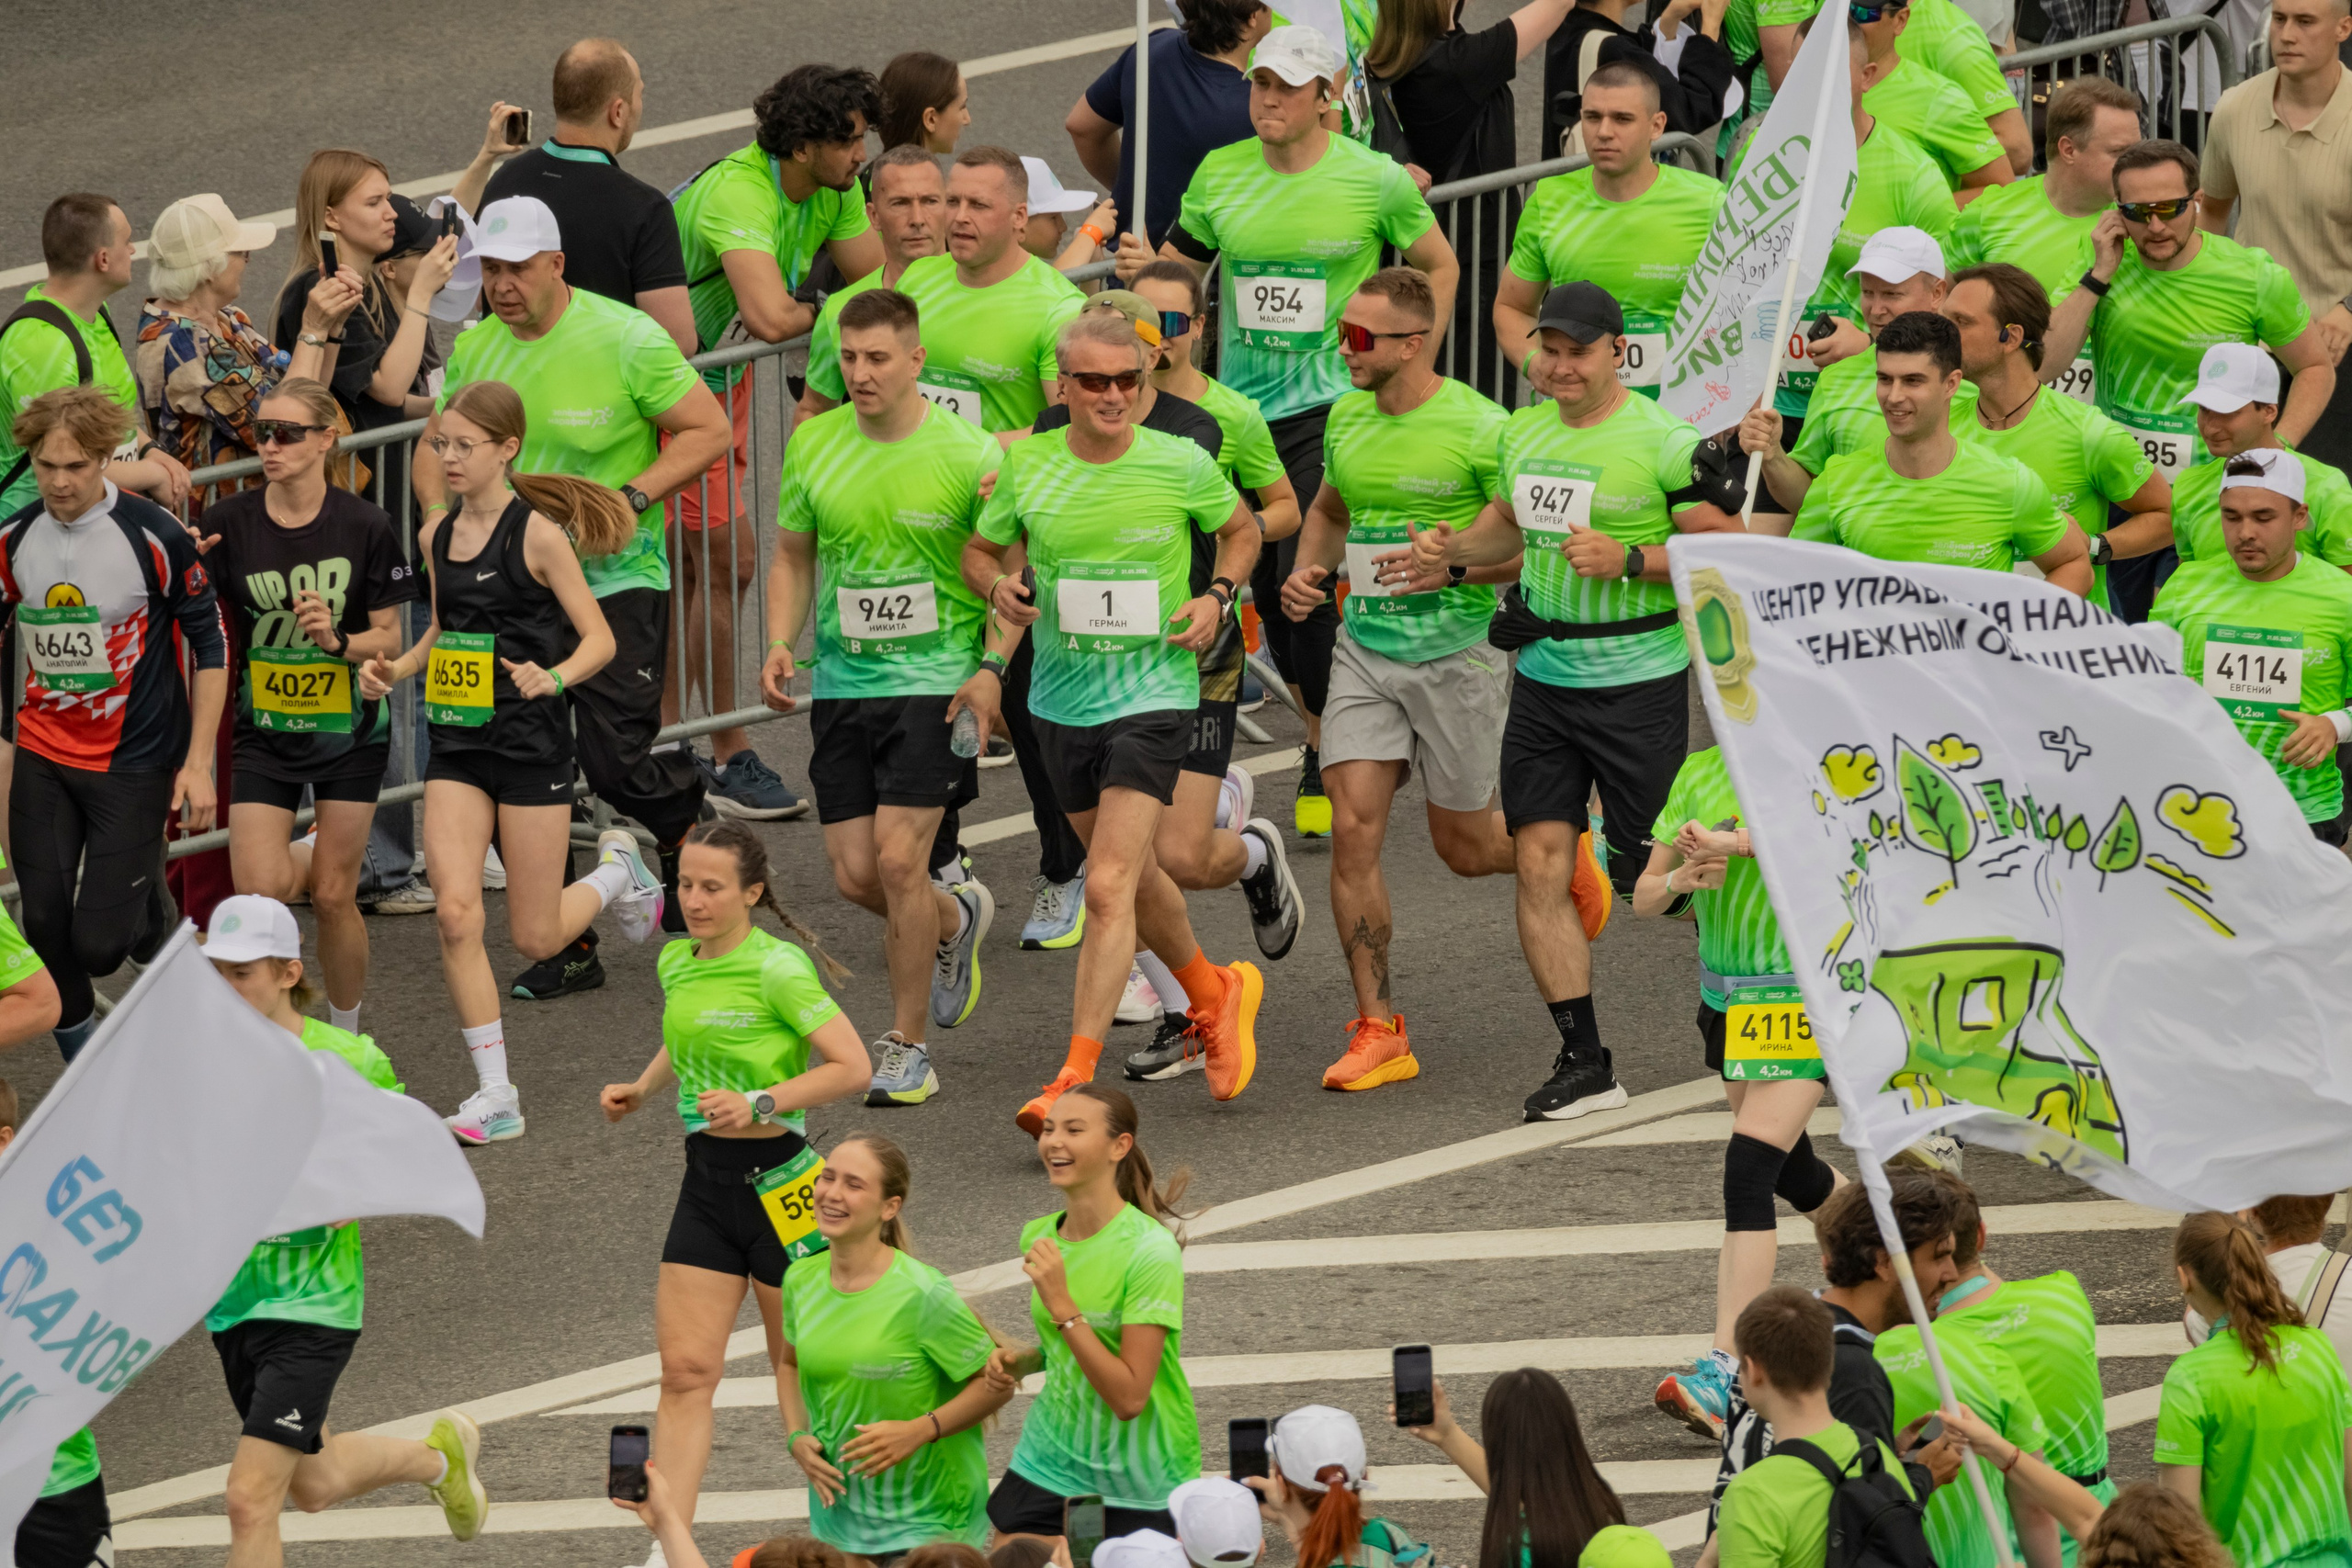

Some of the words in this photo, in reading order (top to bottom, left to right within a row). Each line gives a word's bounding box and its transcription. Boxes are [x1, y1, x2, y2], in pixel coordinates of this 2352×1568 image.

[1254, 286, 1303, 313] 954
[1260, 315, 1295, 324] МАКСИМ
[1530, 485, 1574, 514] 947
[1535, 513, 1563, 525] СЕРГЕЙ
[245, 570, 287, 611] UP
[1102, 590, 1112, 616] 1
[1752, 581, 1826, 627] ЦЕНТР
[859, 594, 913, 622] 942
[869, 622, 907, 632] НИКИТА
[1090, 619, 1127, 627] ГЕРМАН
[35, 631, 94, 659] 6643
[435, 658, 480, 688] 6635
[2216, 652, 2287, 684] 4114
[265, 671, 336, 698] 4027
[2230, 682, 2271, 694] ЕВГЕНИЙ
[281, 699, 321, 707] ПОЛИНА
[1740, 1011, 1813, 1041] 4115
[1759, 1043, 1793, 1052] ИРИНА
[779, 1173, 821, 1220] 58
